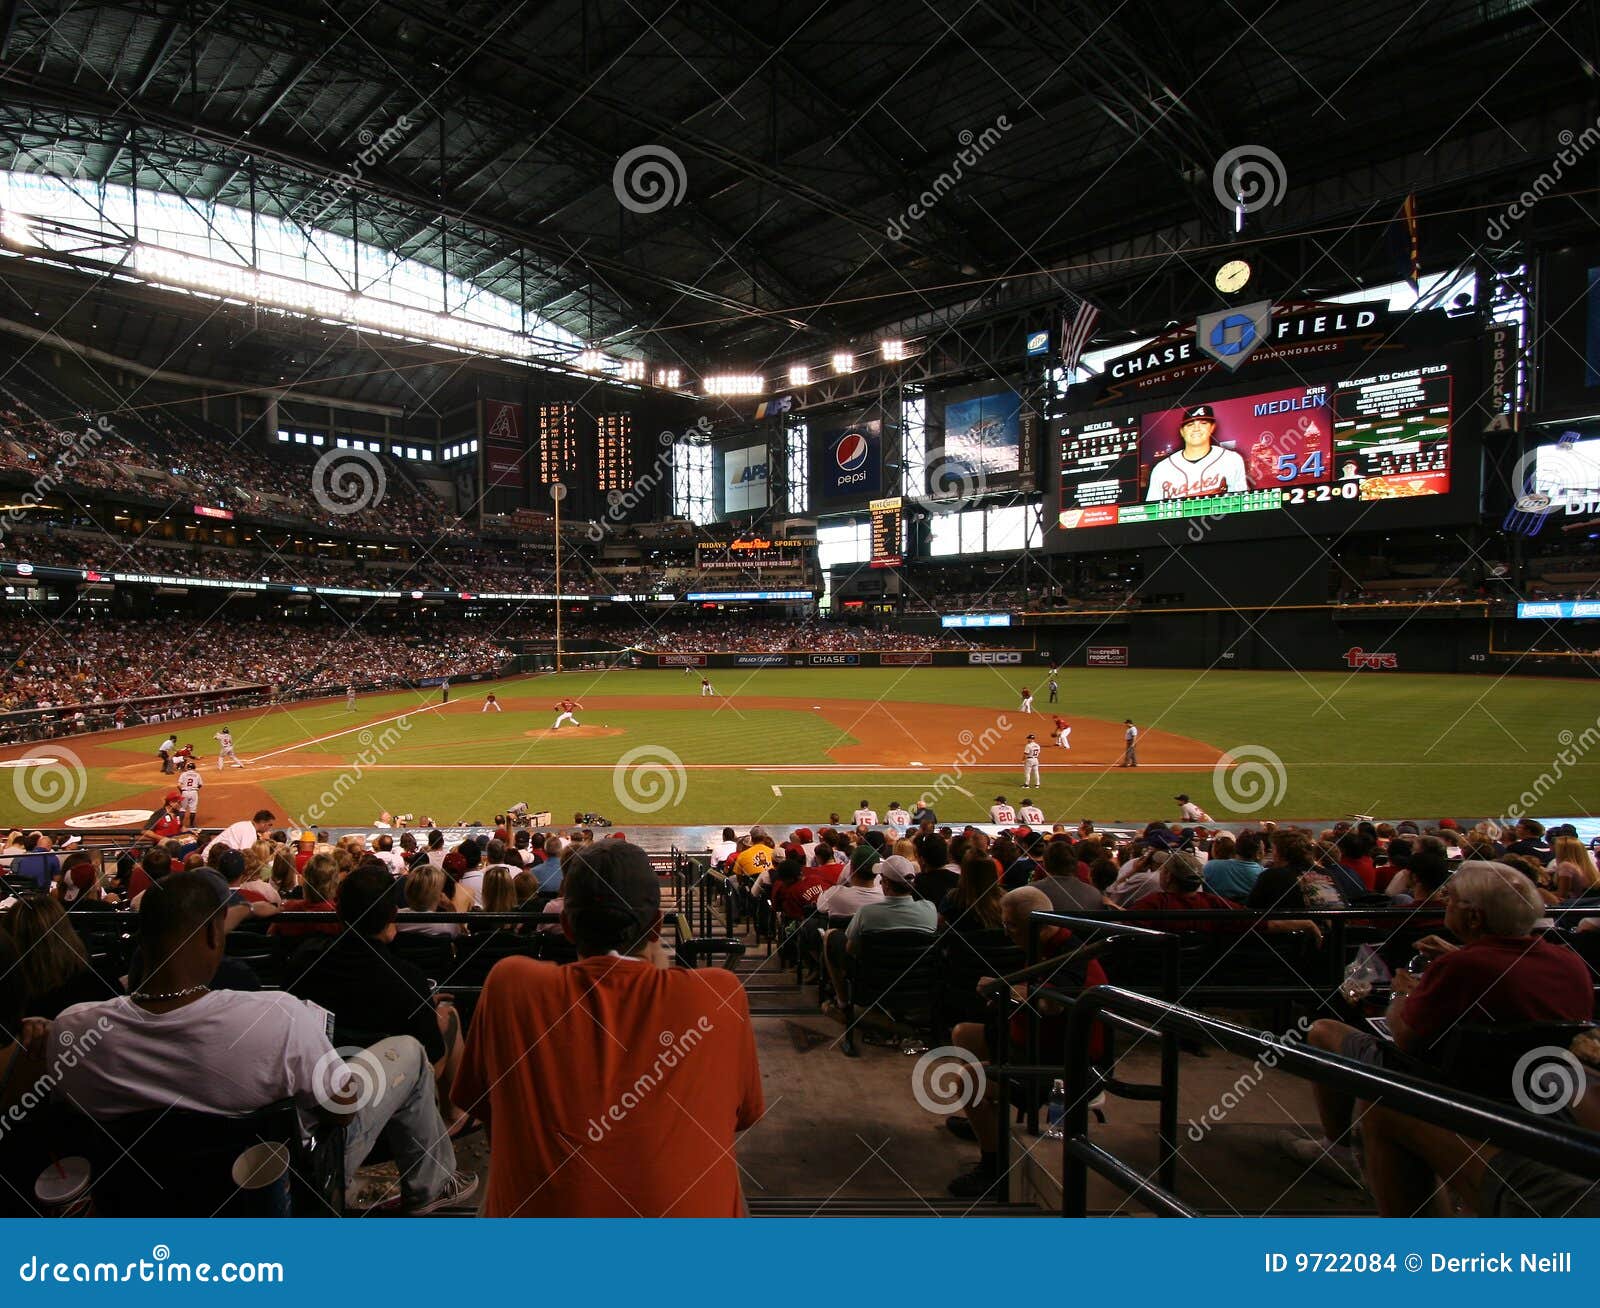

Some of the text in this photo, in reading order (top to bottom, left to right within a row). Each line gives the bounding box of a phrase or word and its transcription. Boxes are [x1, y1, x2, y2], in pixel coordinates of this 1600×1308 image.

[1278, 311, 1375, 338] FIELD
[1111, 343, 1190, 378] CHASE
[1252, 343, 1338, 361] DIAMONDBACKS
[1139, 376, 1167, 387] HOME
[1173, 370, 1187, 379] OF
[1338, 376, 1377, 388] WELCOME
[1392, 369, 1420, 379] CHASE
[1422, 364, 1448, 375] FIELD
[1306, 386, 1326, 395] KRIS
[1254, 394, 1325, 417] MEDLEN
[1061, 428, 1070, 436] 54
[1084, 421, 1112, 432] MEDLEN
[1277, 450, 1326, 481] 54
[837, 470, 867, 487] pepsi
[1290, 488, 1305, 504] 2
[1316, 485, 1331, 502] 2
[1341, 483, 1358, 499] 0
[813, 655, 846, 663] CHASE
[969, 653, 1022, 664] GEICO
[186, 778, 194, 787] 2
[999, 812, 1013, 822] 20
[1028, 813, 1041, 823] 14
